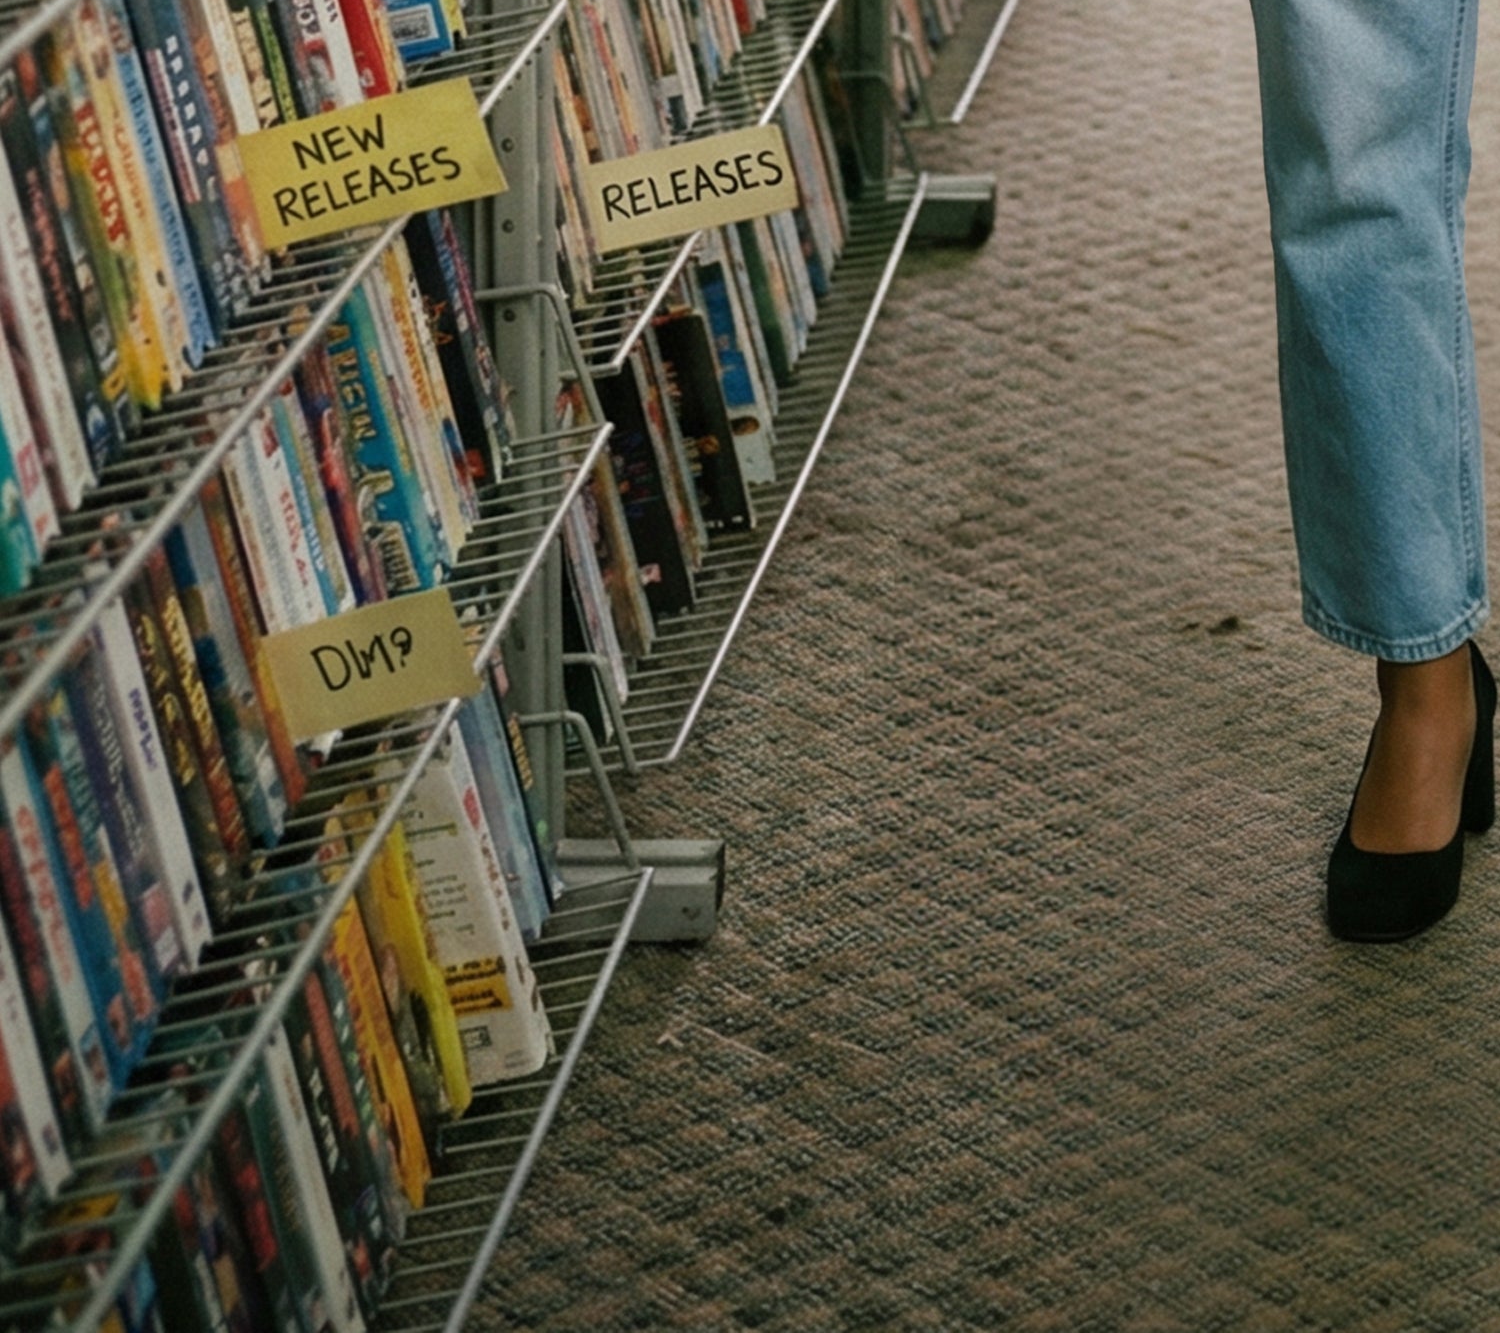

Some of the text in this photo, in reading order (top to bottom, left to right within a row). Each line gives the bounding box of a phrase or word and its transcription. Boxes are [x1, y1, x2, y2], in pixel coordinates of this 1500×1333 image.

[291, 113, 387, 170] NEW
[273, 146, 462, 226] RELEASES
[601, 150, 784, 222] RELEASES
